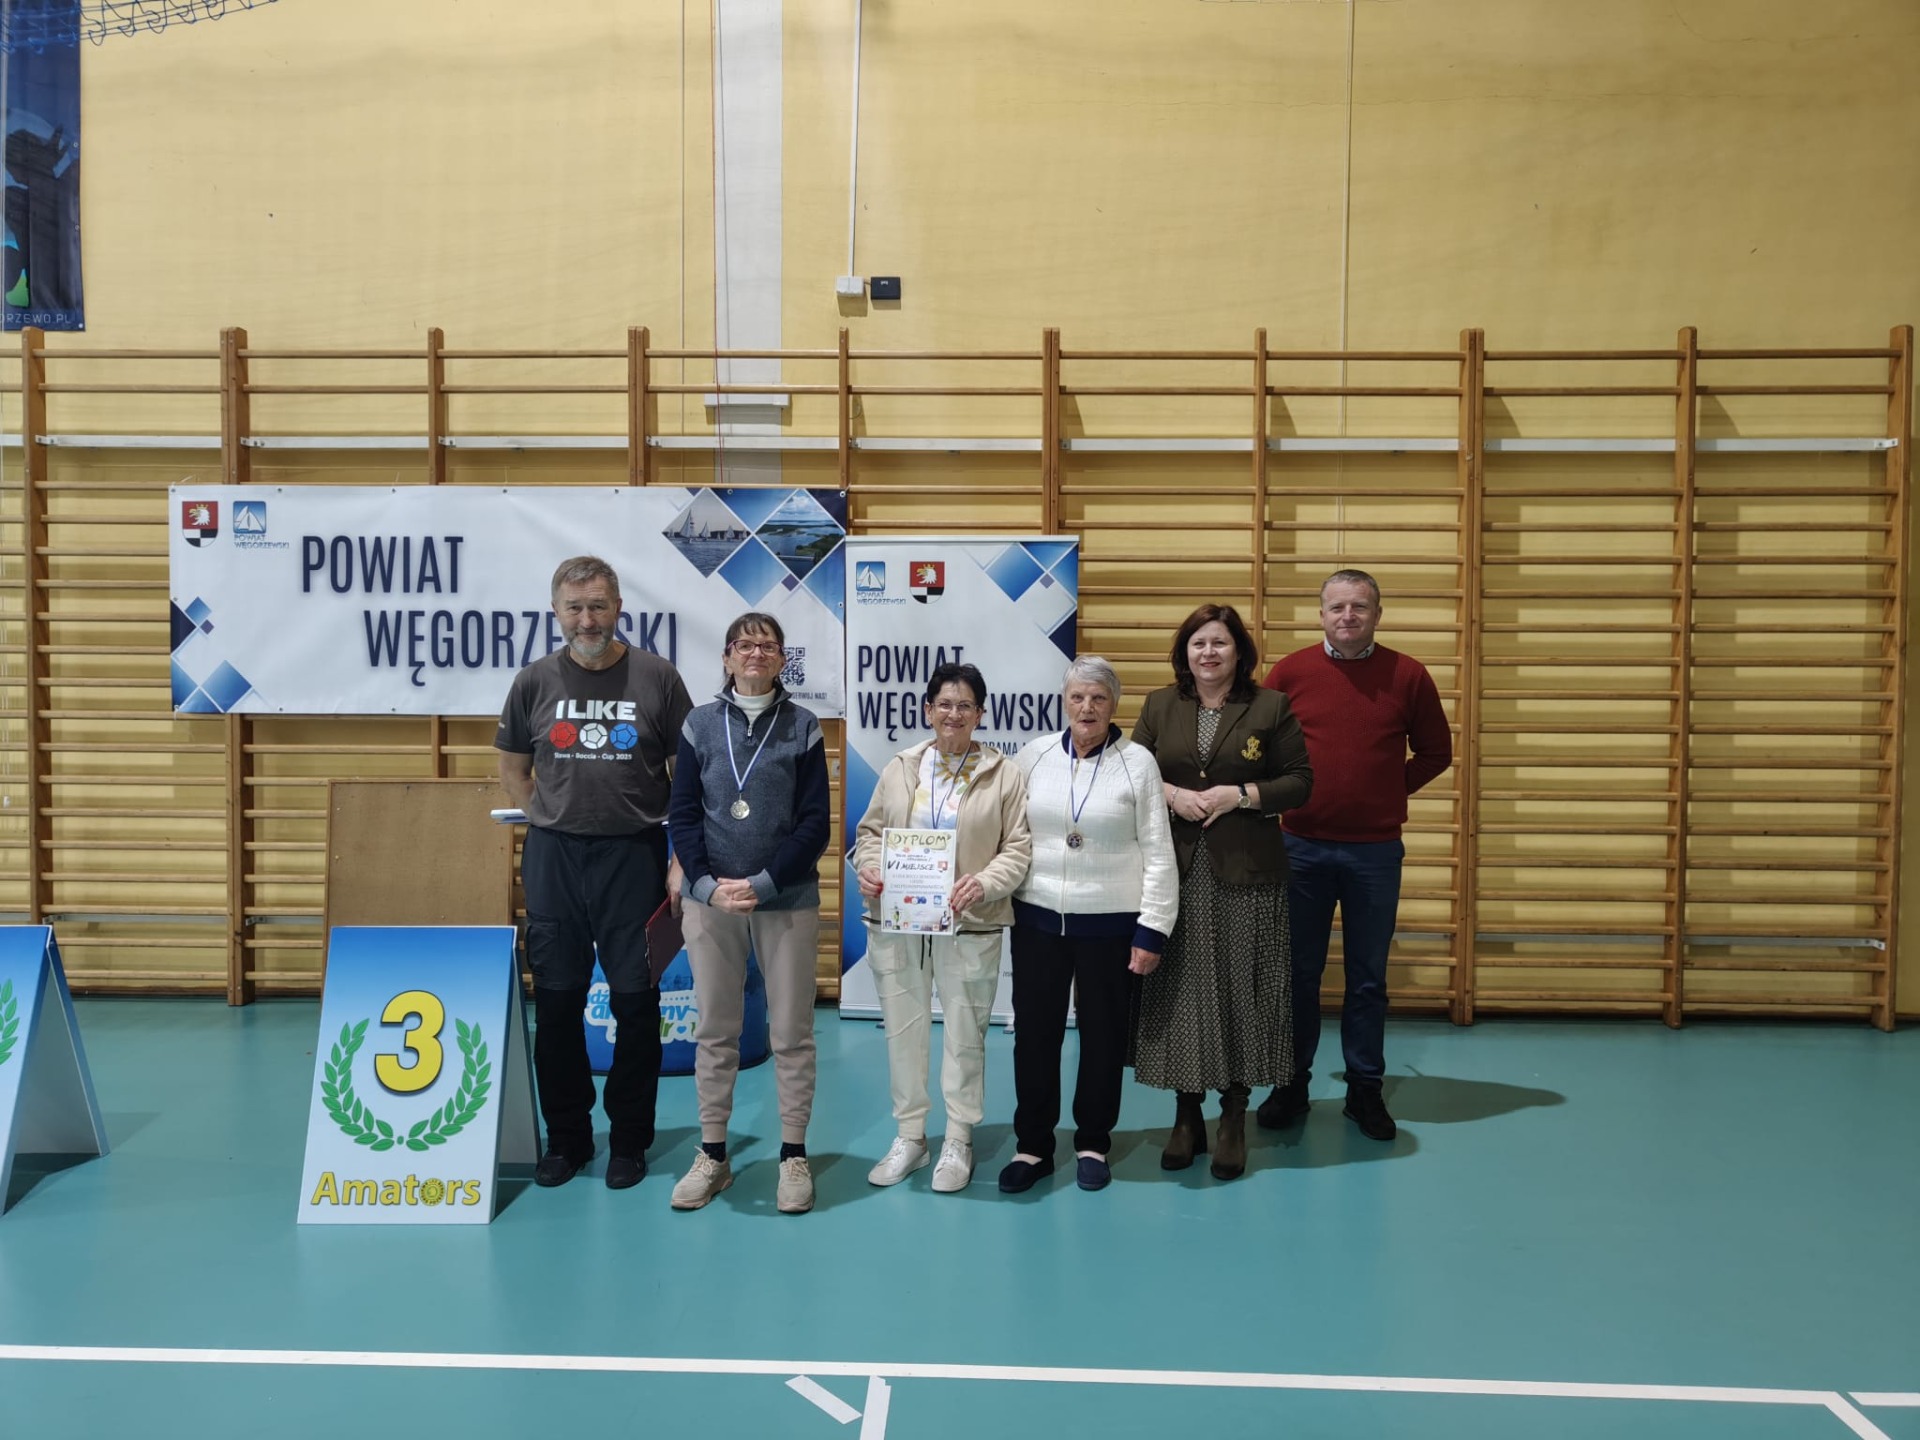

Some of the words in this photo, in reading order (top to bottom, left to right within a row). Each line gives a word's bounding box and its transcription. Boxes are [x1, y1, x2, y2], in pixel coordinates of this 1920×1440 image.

[302, 535, 464, 593] POWIAT
[363, 610, 677, 687] WĘGORZESKI
[555, 699, 566, 719] I
[567, 699, 637, 721] LIKE
[575, 752, 597, 760] Boccia
[601, 753, 615, 761] Cup
[374, 989, 446, 1093] 3
[310, 1171, 481, 1207] Amators
